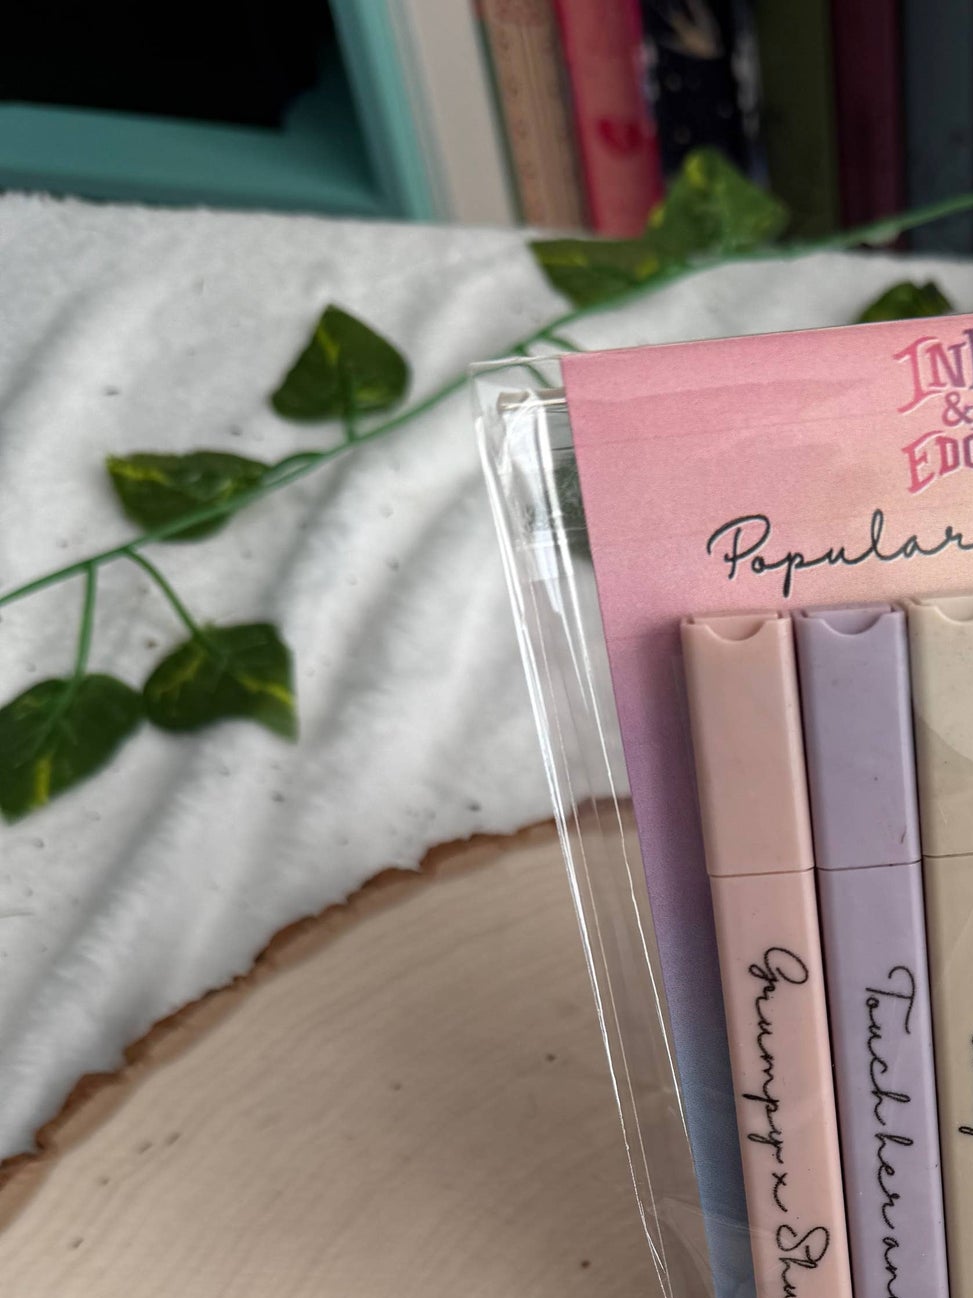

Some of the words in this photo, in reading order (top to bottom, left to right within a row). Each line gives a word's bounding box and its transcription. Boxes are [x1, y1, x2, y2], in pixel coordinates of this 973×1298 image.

[743, 946, 809, 1165] Grumpy
[866, 965, 917, 1127] Touch
[771, 1171, 788, 1213] x
[874, 1132, 914, 1231] her
